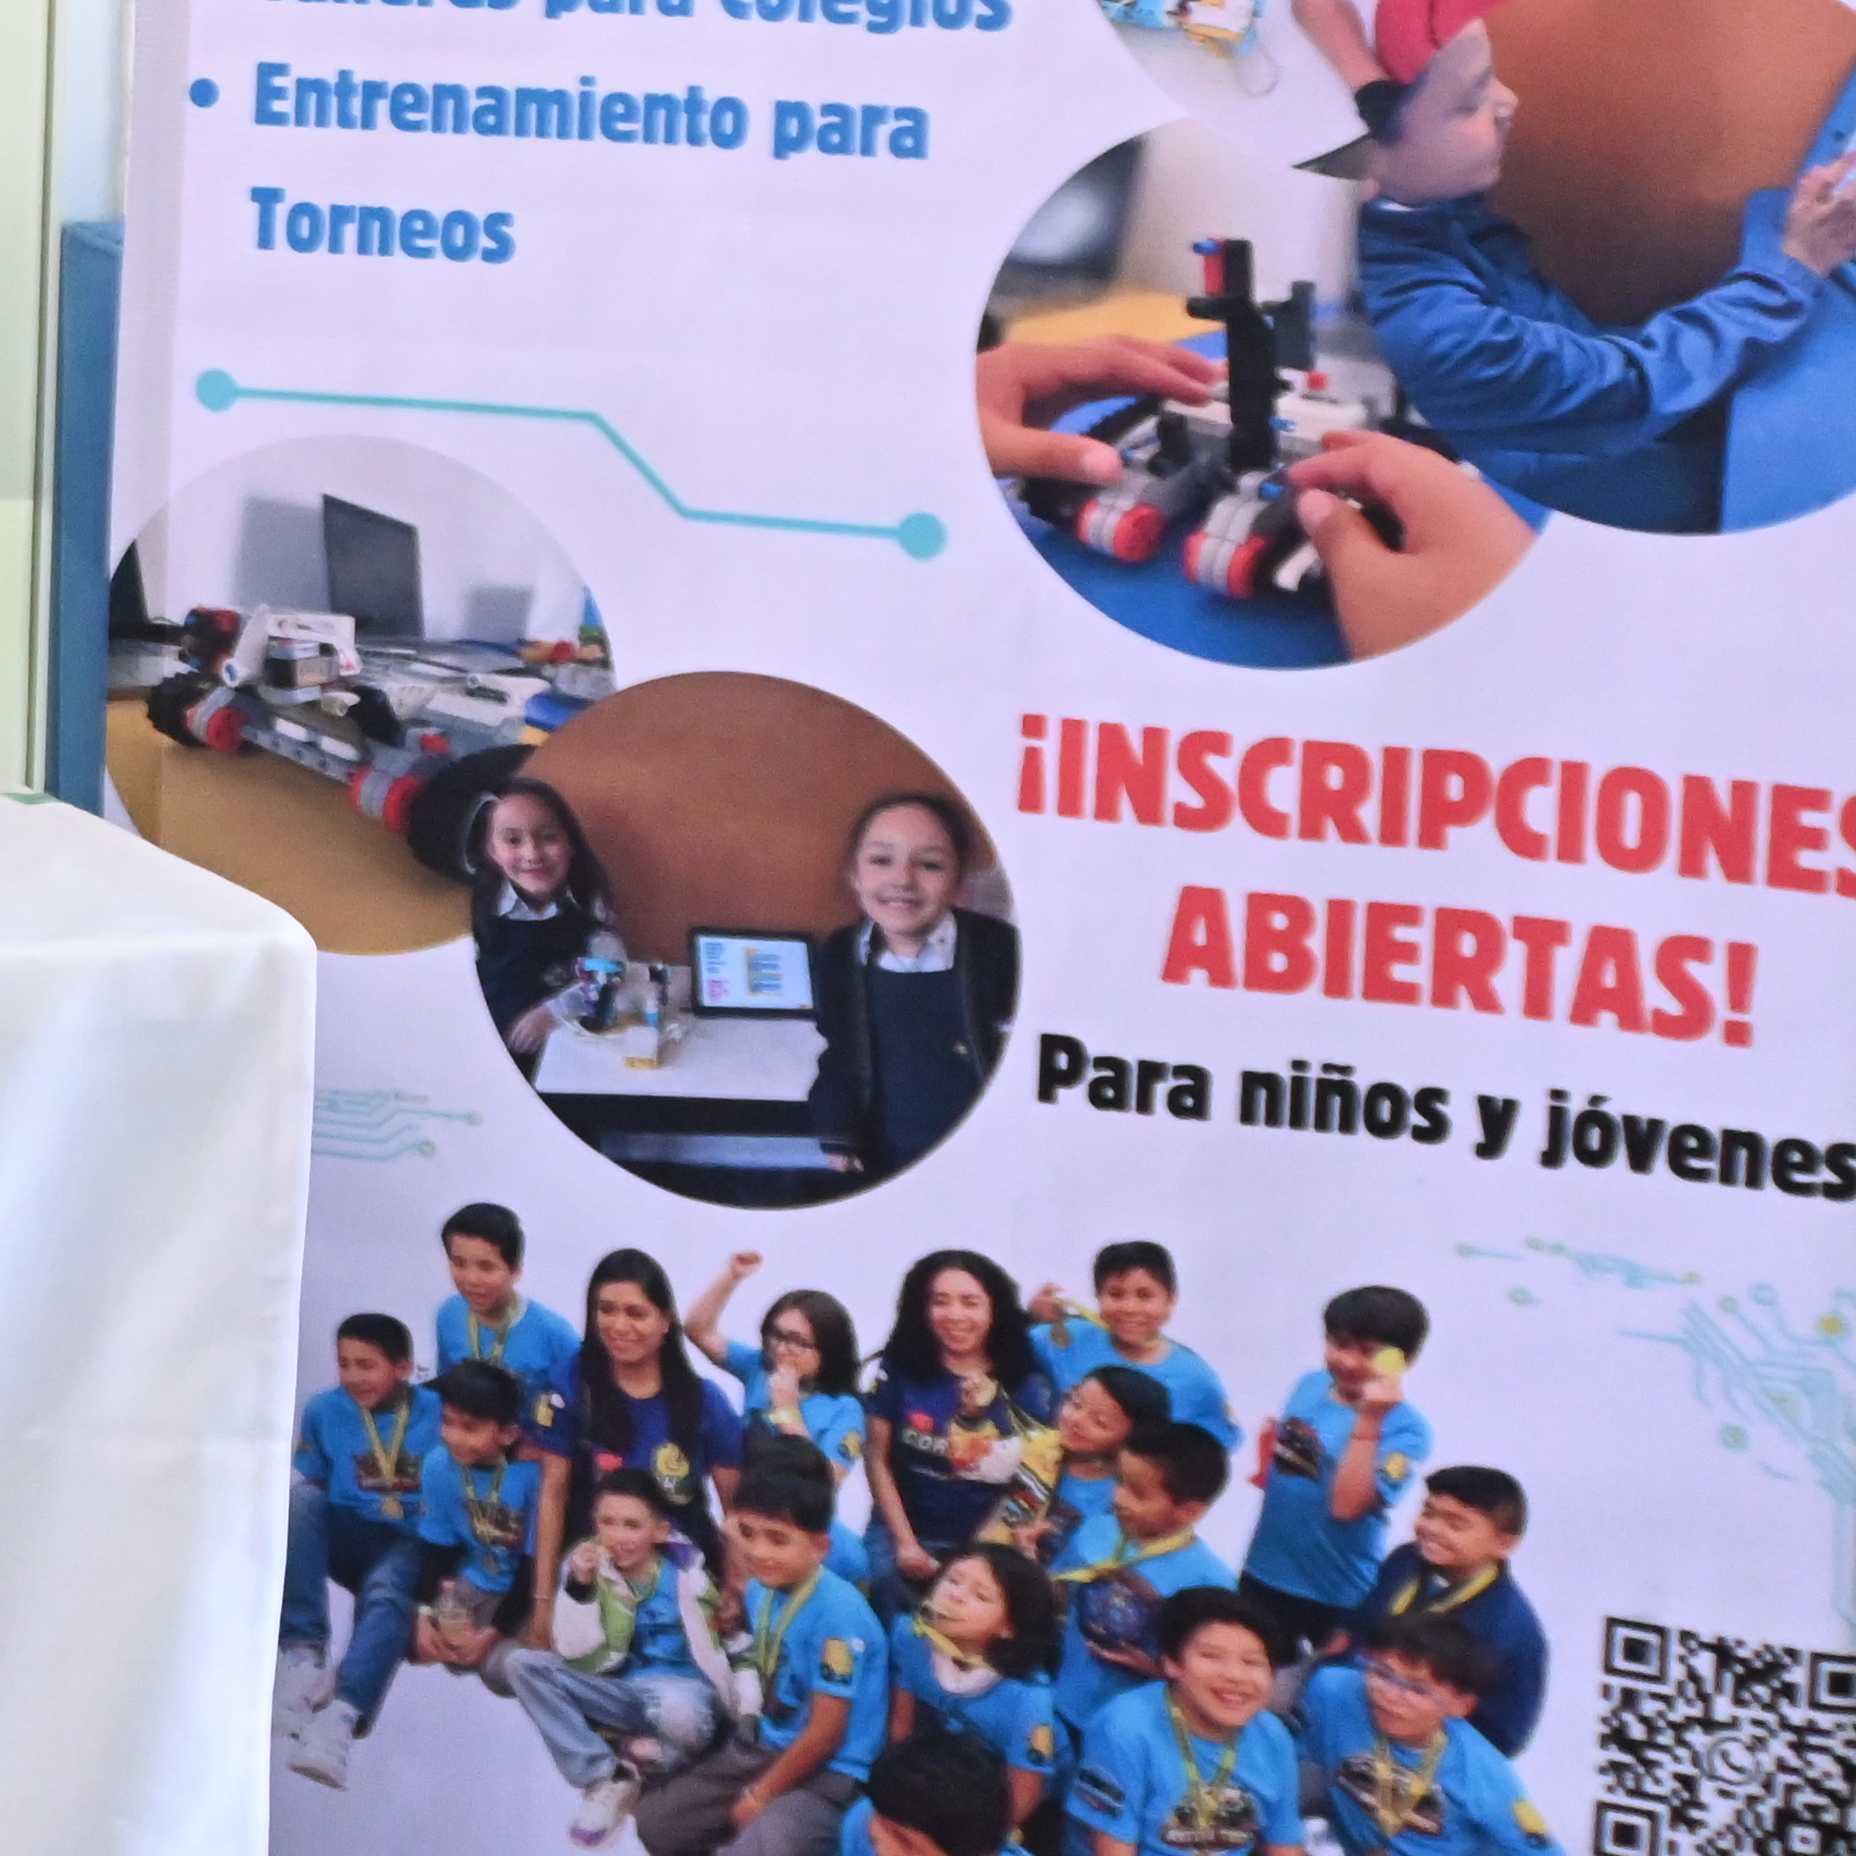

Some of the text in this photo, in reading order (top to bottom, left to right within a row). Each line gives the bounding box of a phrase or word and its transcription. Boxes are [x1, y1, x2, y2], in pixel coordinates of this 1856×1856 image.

[255, 62, 928, 160] Entrenamiento para
[251, 187, 515, 263] Torneos
[1161, 885, 1759, 1048] ABIERTAS!
[1038, 1033, 1856, 1201] Para niños y jóvenes
